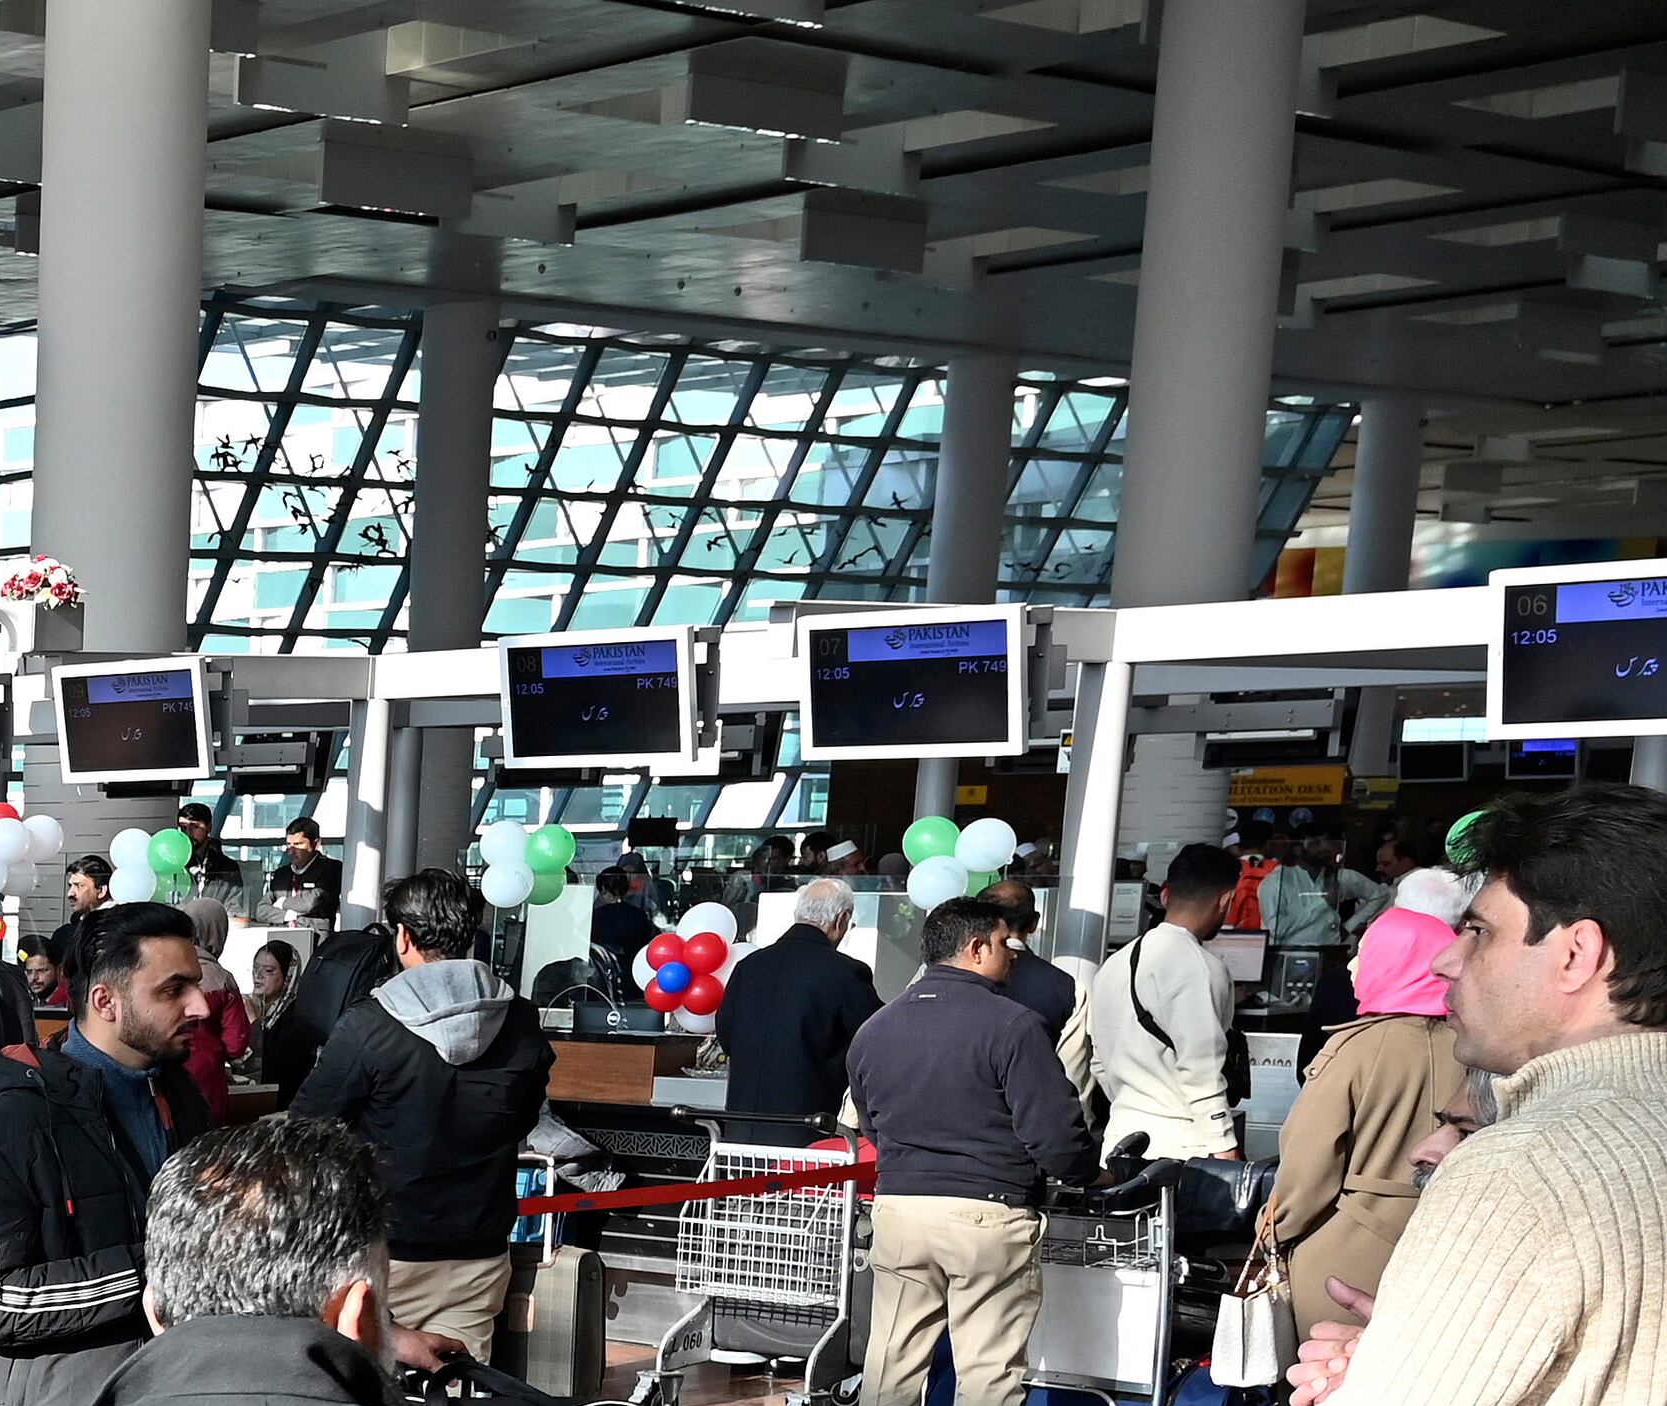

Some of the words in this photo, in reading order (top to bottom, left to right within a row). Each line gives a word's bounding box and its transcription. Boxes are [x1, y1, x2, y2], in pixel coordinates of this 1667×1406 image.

[1517, 594, 1548, 616] 06
[908, 625, 970, 640] PAKISTAN
[1511, 629, 1557, 645] 12:05
[593, 645, 646, 660] PAKISTAN
[819, 637, 841, 656] 07
[517, 655, 536, 673] 08
[958, 661, 979, 674] PK
[983, 660, 1007, 673] 749
[1615, 655, 1660, 678] پیرس
[817, 666, 850, 680] 12:05
[127, 674, 168, 688] PAKISTAN
[637, 677, 654, 690] PK
[656, 676, 678, 689] 749
[516, 683, 544, 695] 12:05
[162, 702, 176, 713] PK
[1297, 784, 1332, 793] DESK
[682, 1331, 703, 1352] 060
